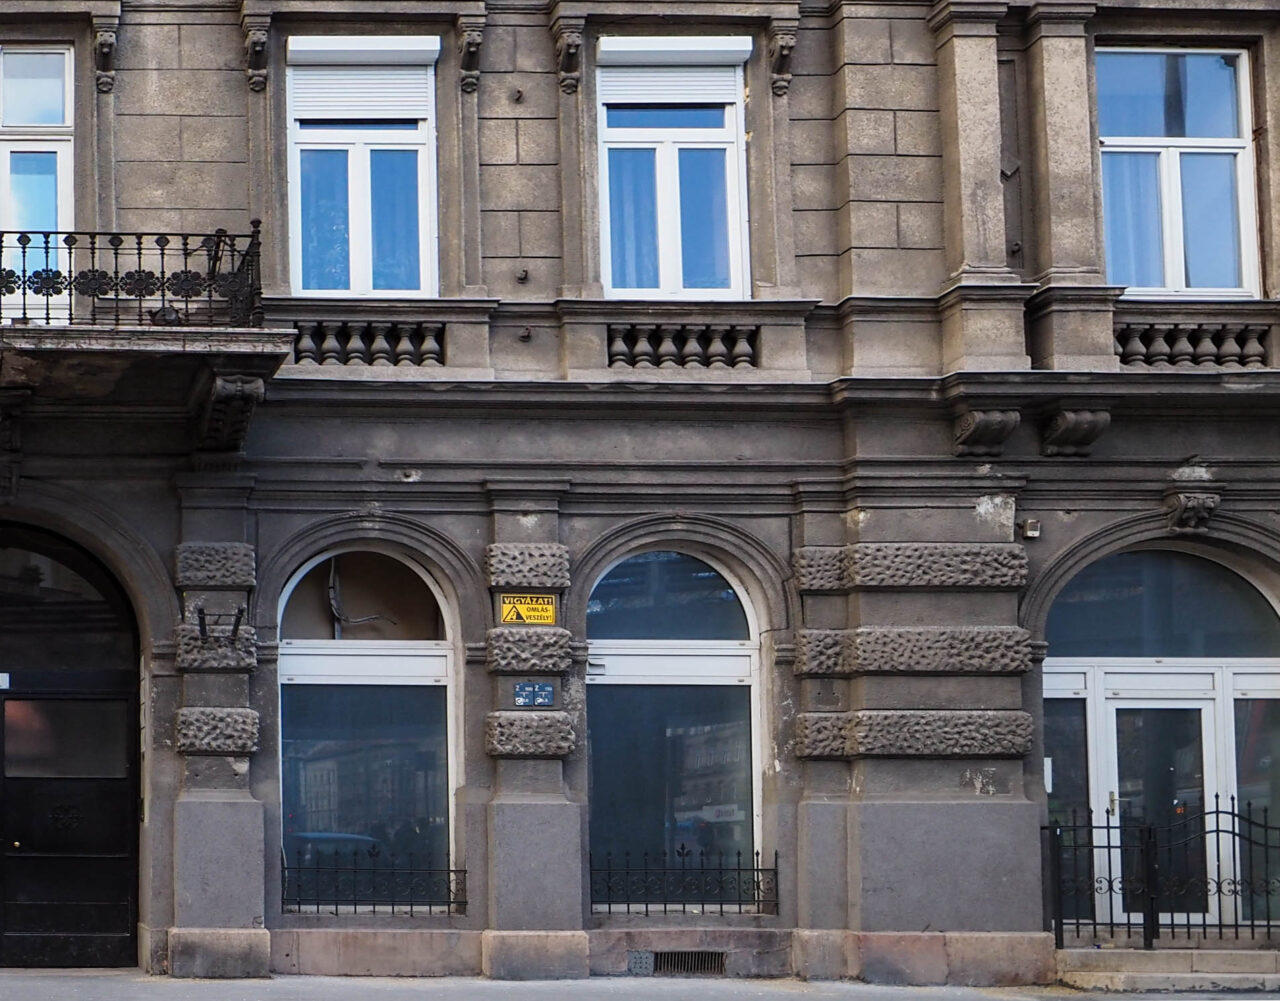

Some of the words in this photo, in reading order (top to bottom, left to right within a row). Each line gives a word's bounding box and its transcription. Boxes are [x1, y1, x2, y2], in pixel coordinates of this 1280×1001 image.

[503, 596, 553, 605] VIGYÁZAT!
[526, 605, 551, 613] OMLÁS-
[525, 613, 552, 621] VESZÉLY!
